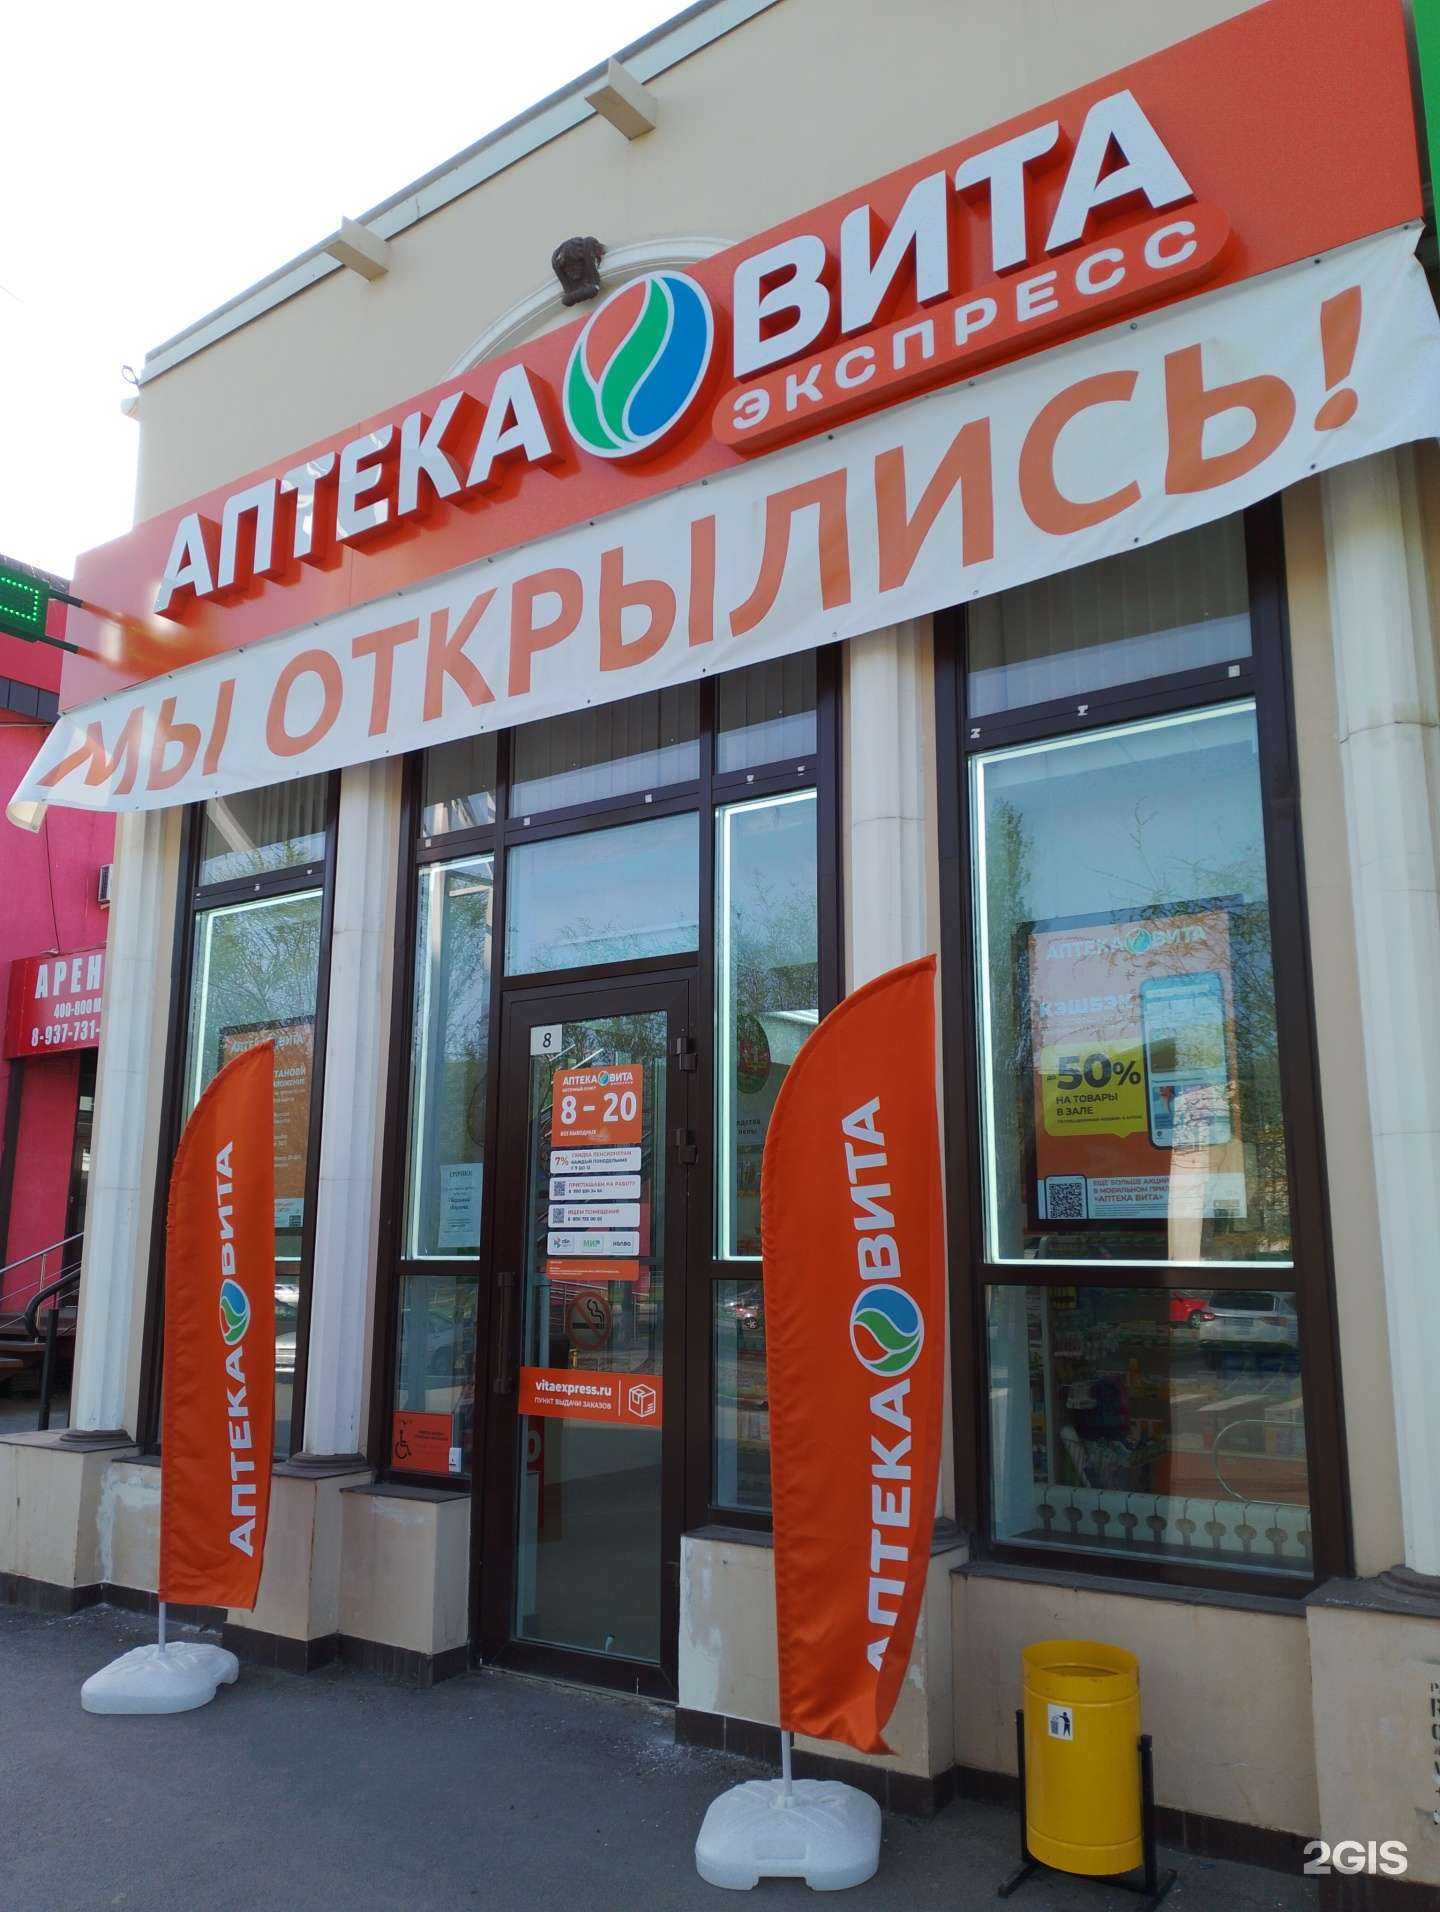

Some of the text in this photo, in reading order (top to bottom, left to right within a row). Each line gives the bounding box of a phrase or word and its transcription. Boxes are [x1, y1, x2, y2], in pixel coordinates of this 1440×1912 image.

[732, 220, 1197, 429] ЭКСПРЕСС
[154, 89, 1194, 613] АПТЕКА ВИТА
[37, 286, 1363, 796] МЫ ОТКРЫЛИСЬ!
[34, 954, 103, 999] АРЕН
[31, 1019, 101, 1047] 8-937-731-
[542, 1032, 552, 1049] 8
[562, 1074, 598, 1086] АПТЕКА
[609, 1071, 634, 1082] ВИТА
[1057, 1053, 1141, 1090] 50%
[561, 1095, 577, 1125] 8
[603, 1091, 637, 1122] 20
[1056, 1092, 1118, 1105] НА ТОВАРЫ
[1056, 1106, 1094, 1117] В ЗАЛЕ
[554, 1156, 569, 1167] 7%
[215, 1141, 257, 1557] АПТЕКА ВИТА
[535, 1379, 612, 1397] vitaexpress.ru
[842, 1096, 912, 1673] АПТЕКА ВИТА
[534, 1396, 612, 1410] ПУНКТ ВЫДАЧИ ЗАКАЗОВ
